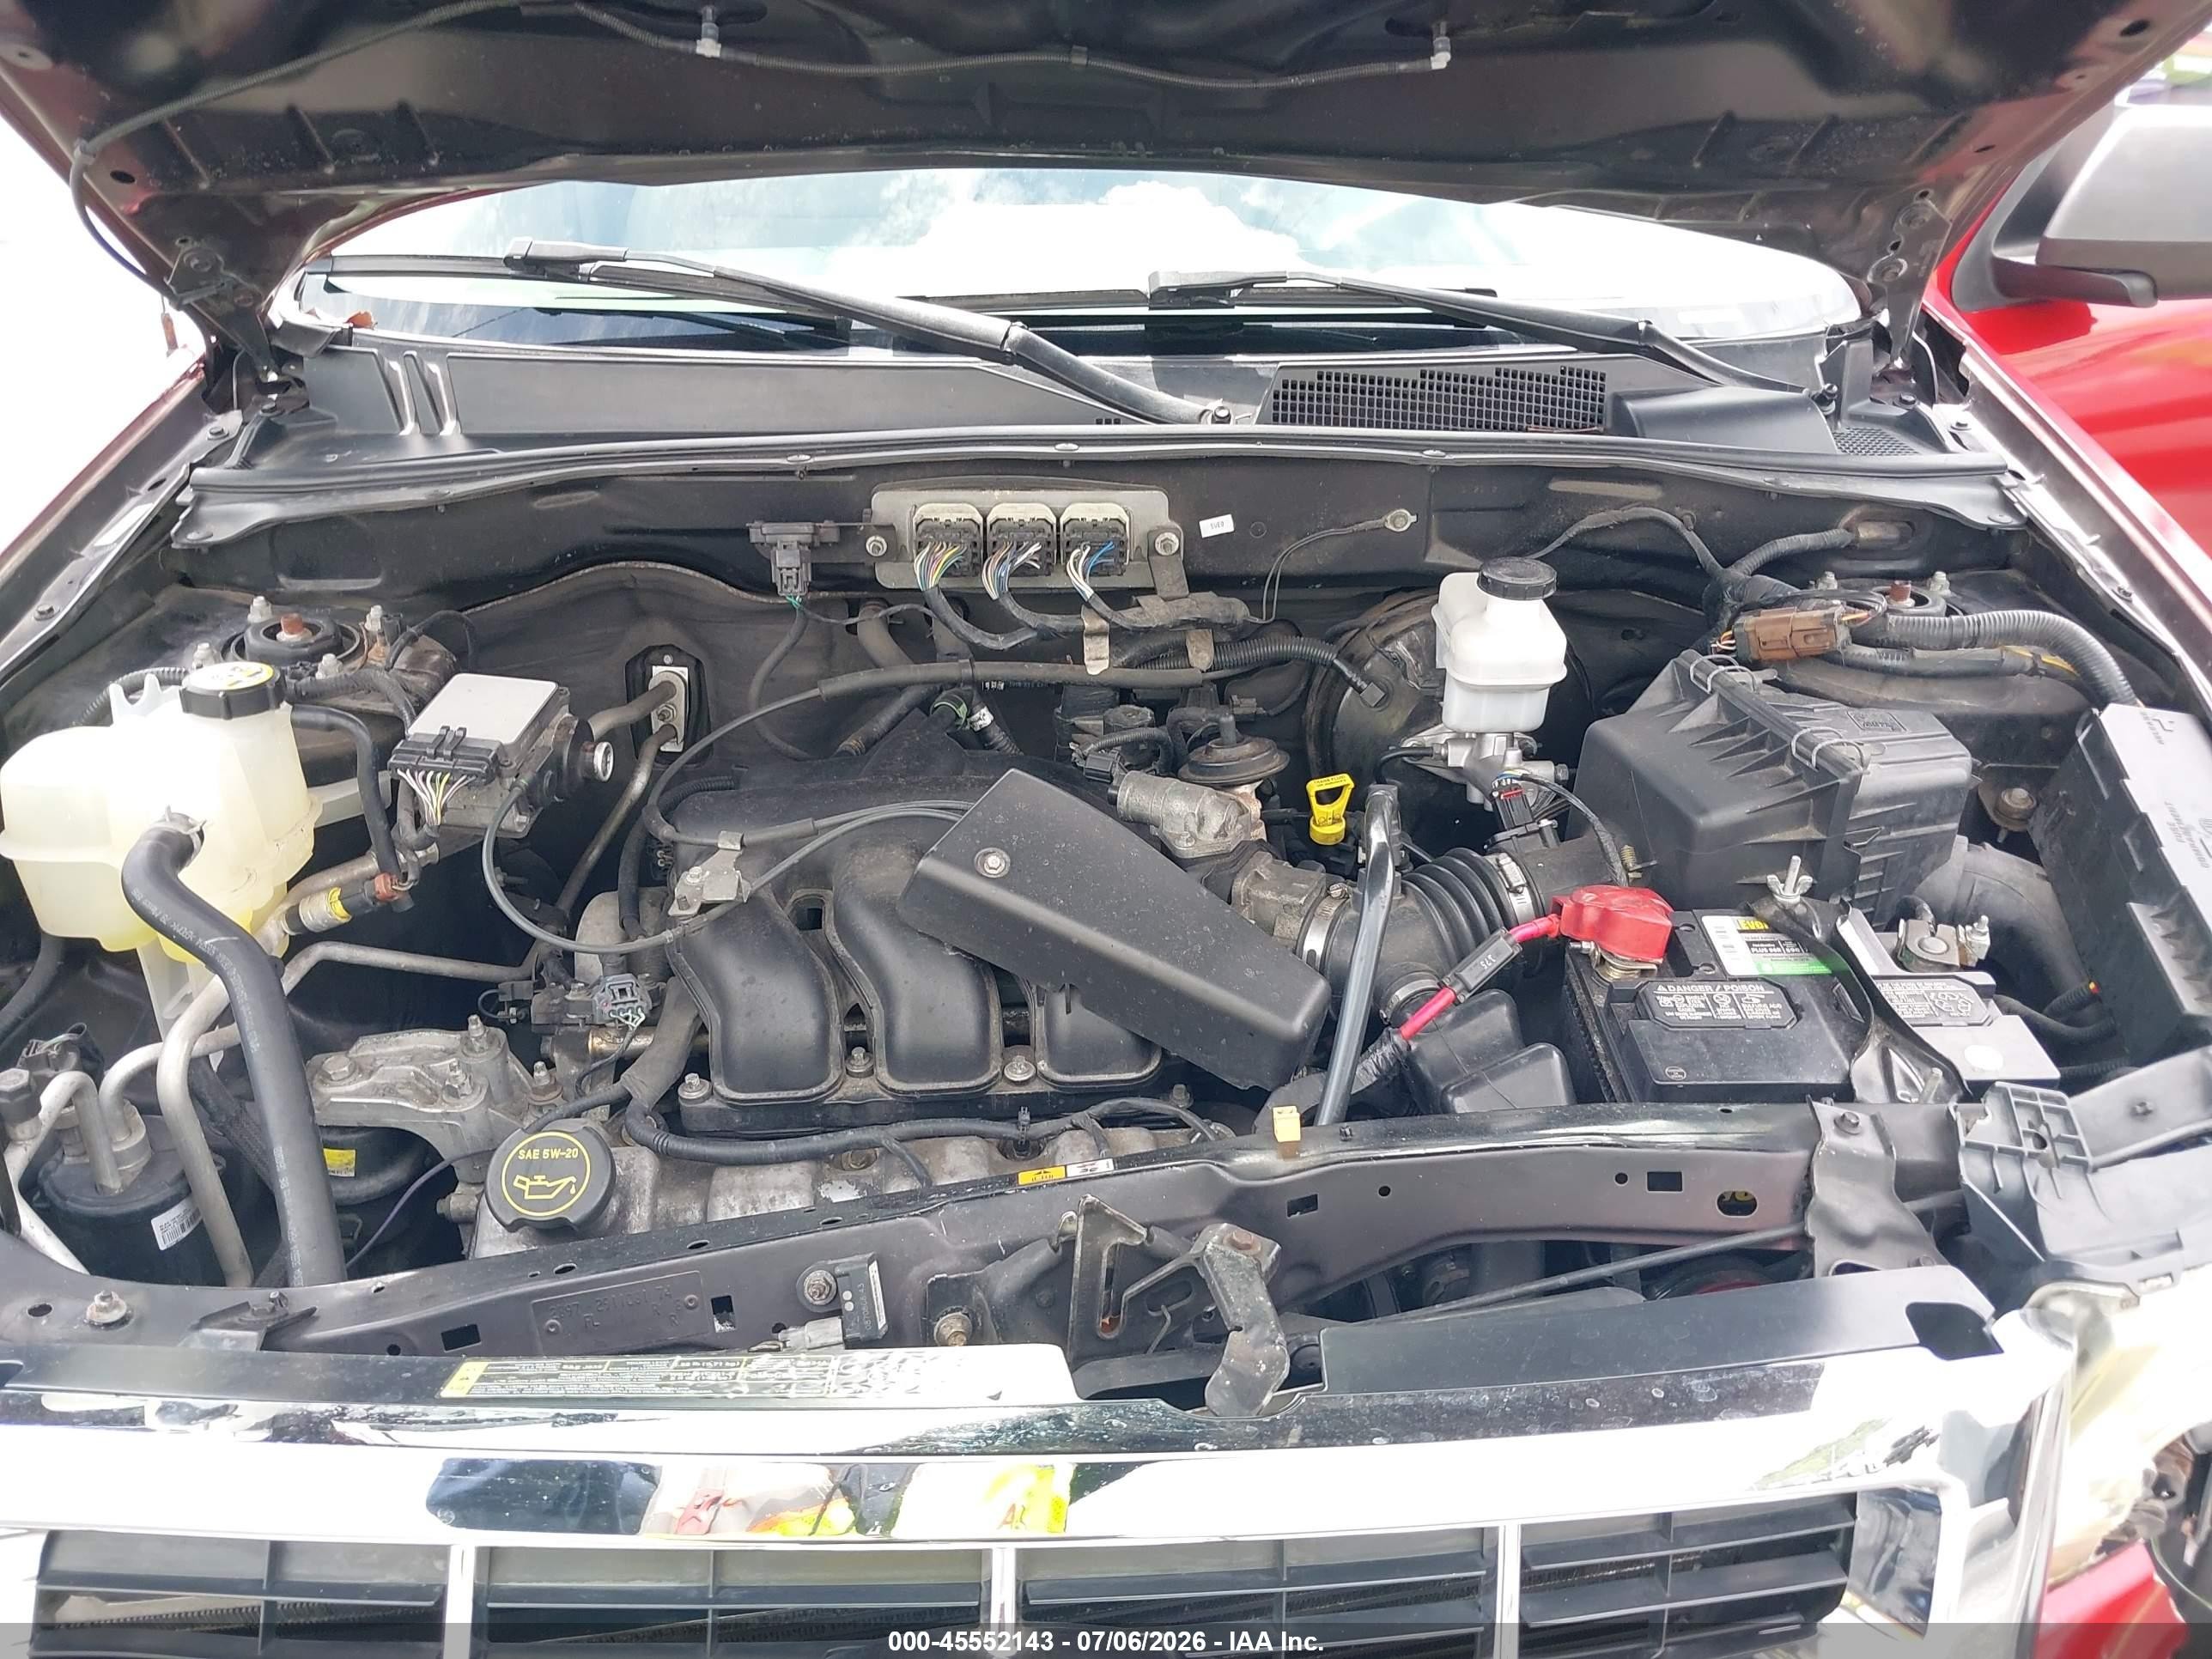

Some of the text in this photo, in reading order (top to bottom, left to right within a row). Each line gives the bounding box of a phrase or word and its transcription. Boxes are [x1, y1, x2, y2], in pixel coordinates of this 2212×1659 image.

[1480, 954, 1496, 969] 175
[518, 1148, 579, 1160] SAE 5W-20
